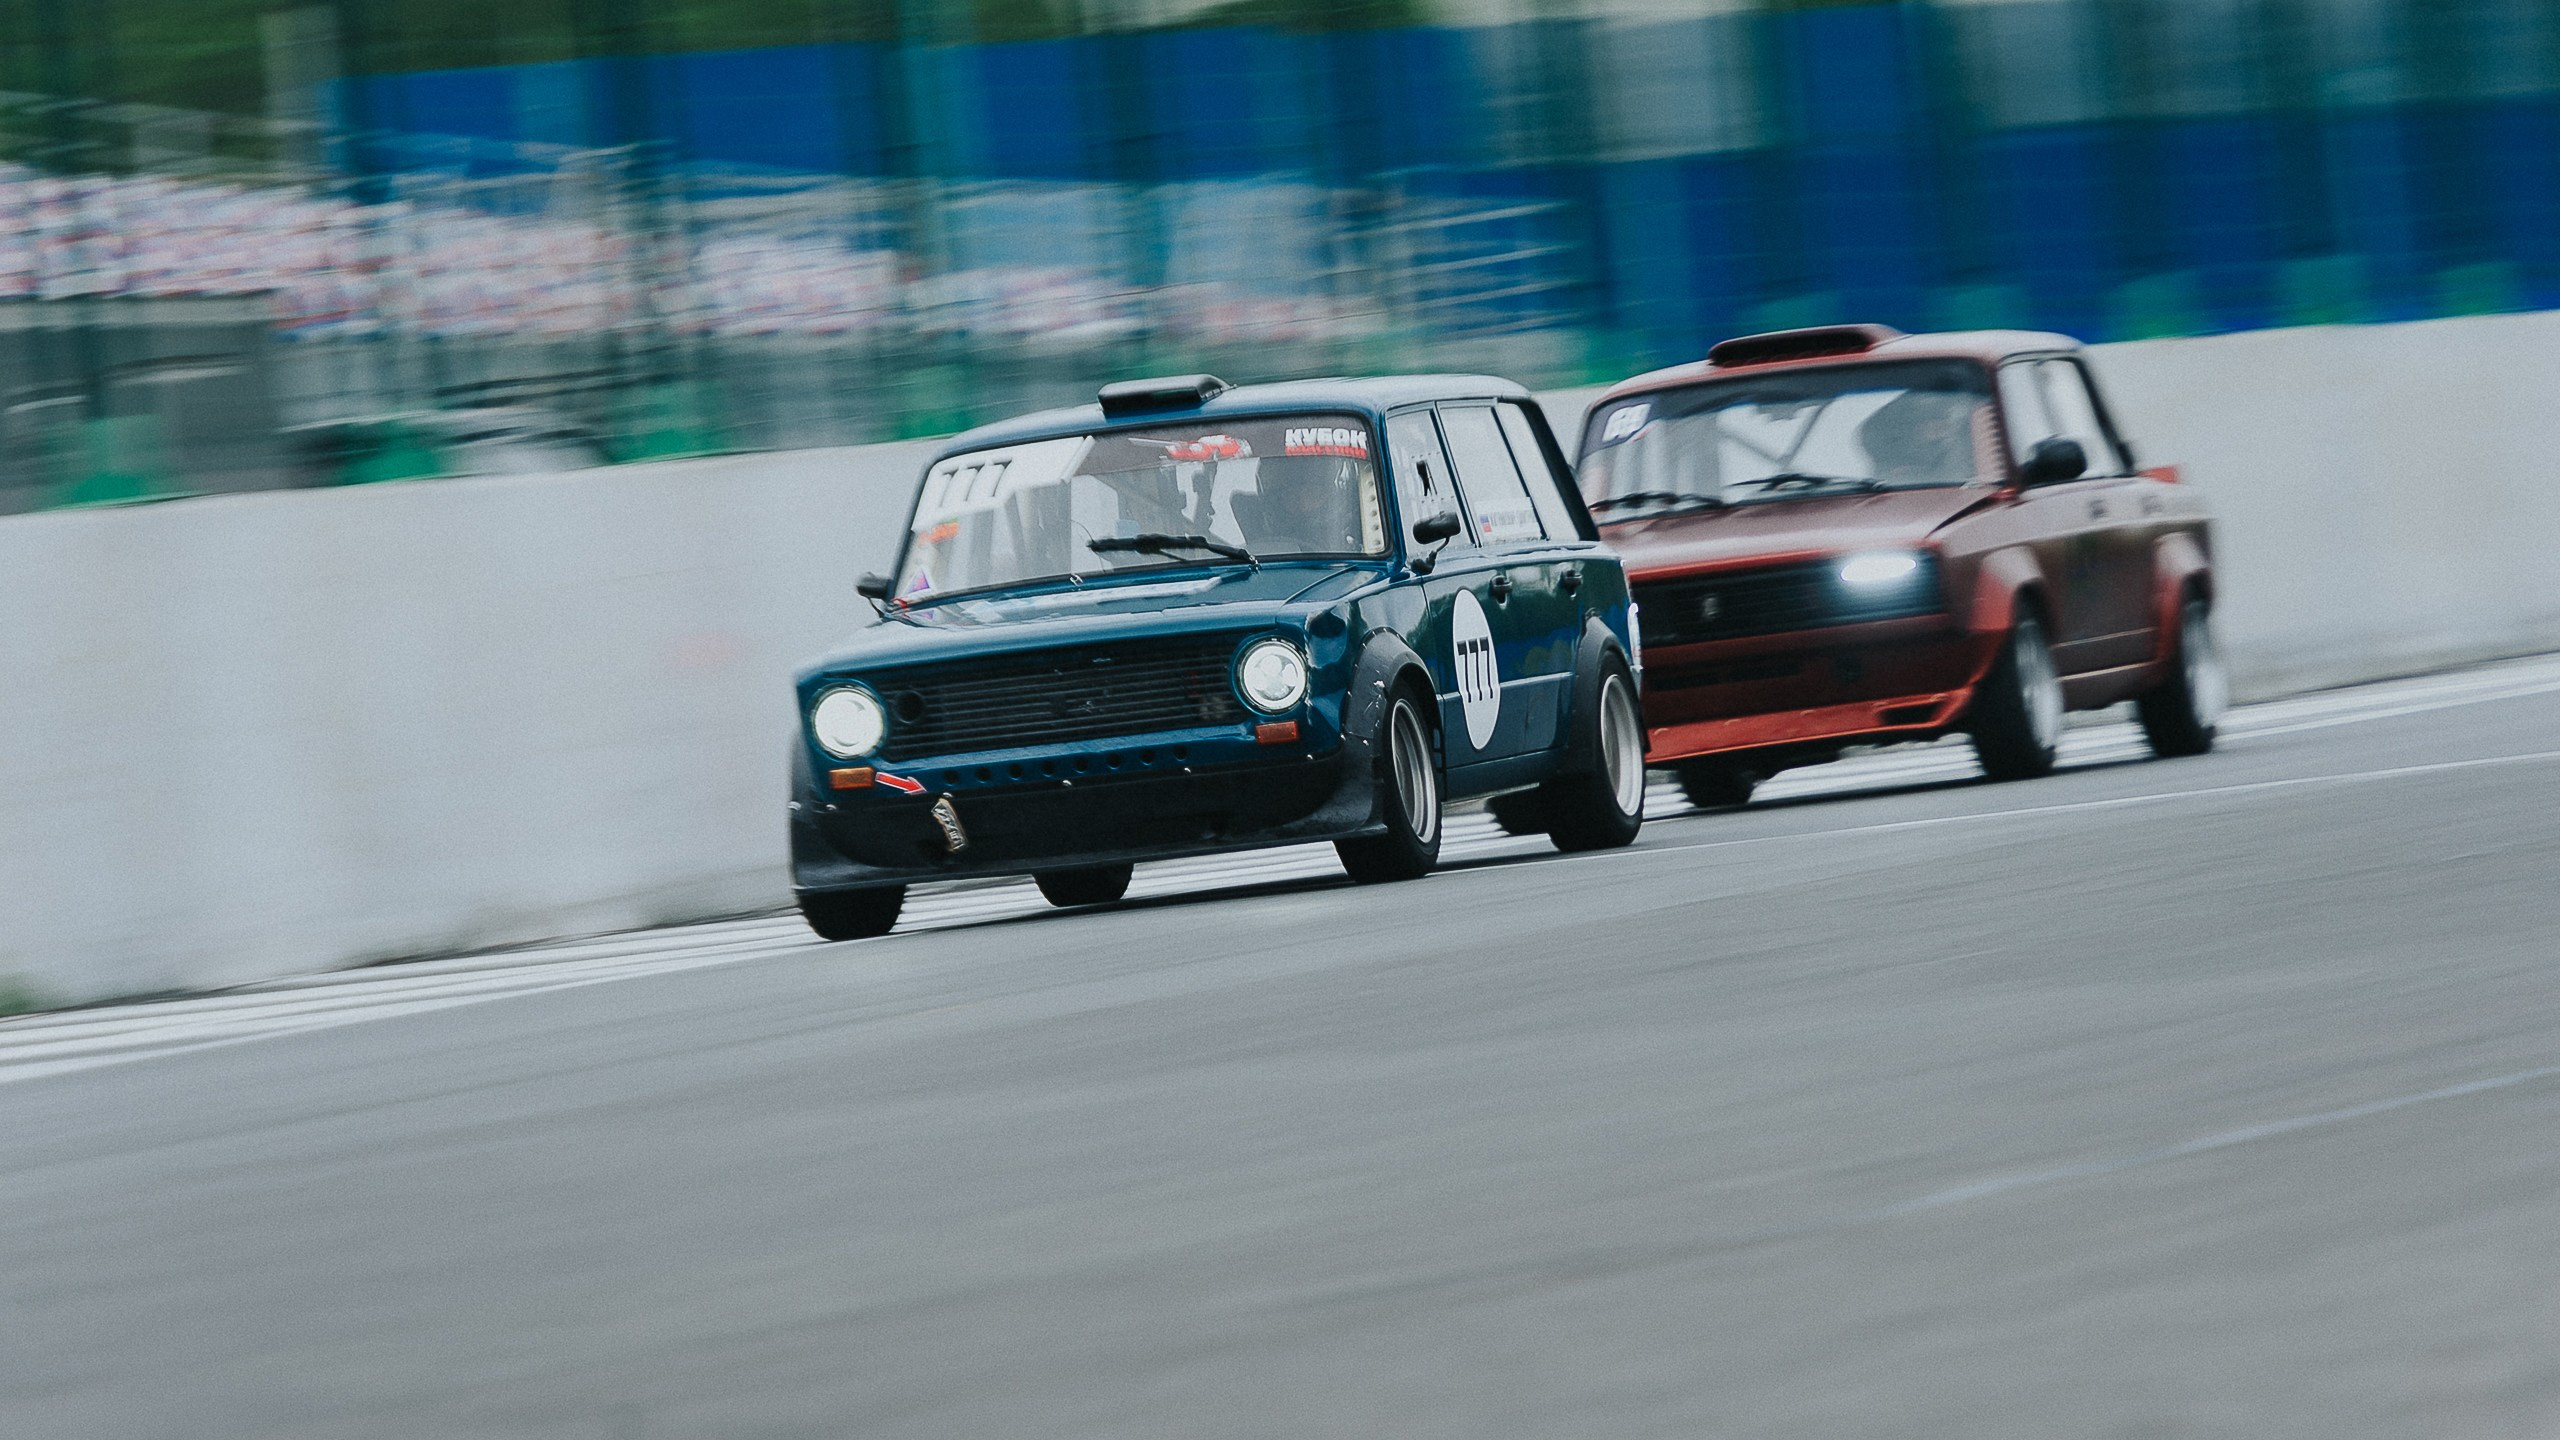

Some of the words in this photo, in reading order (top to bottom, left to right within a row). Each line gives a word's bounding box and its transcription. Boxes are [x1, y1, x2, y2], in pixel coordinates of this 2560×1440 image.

[1284, 428, 1368, 449] КУБОК
[939, 457, 1013, 508] 777
[1456, 635, 1494, 703] 777
